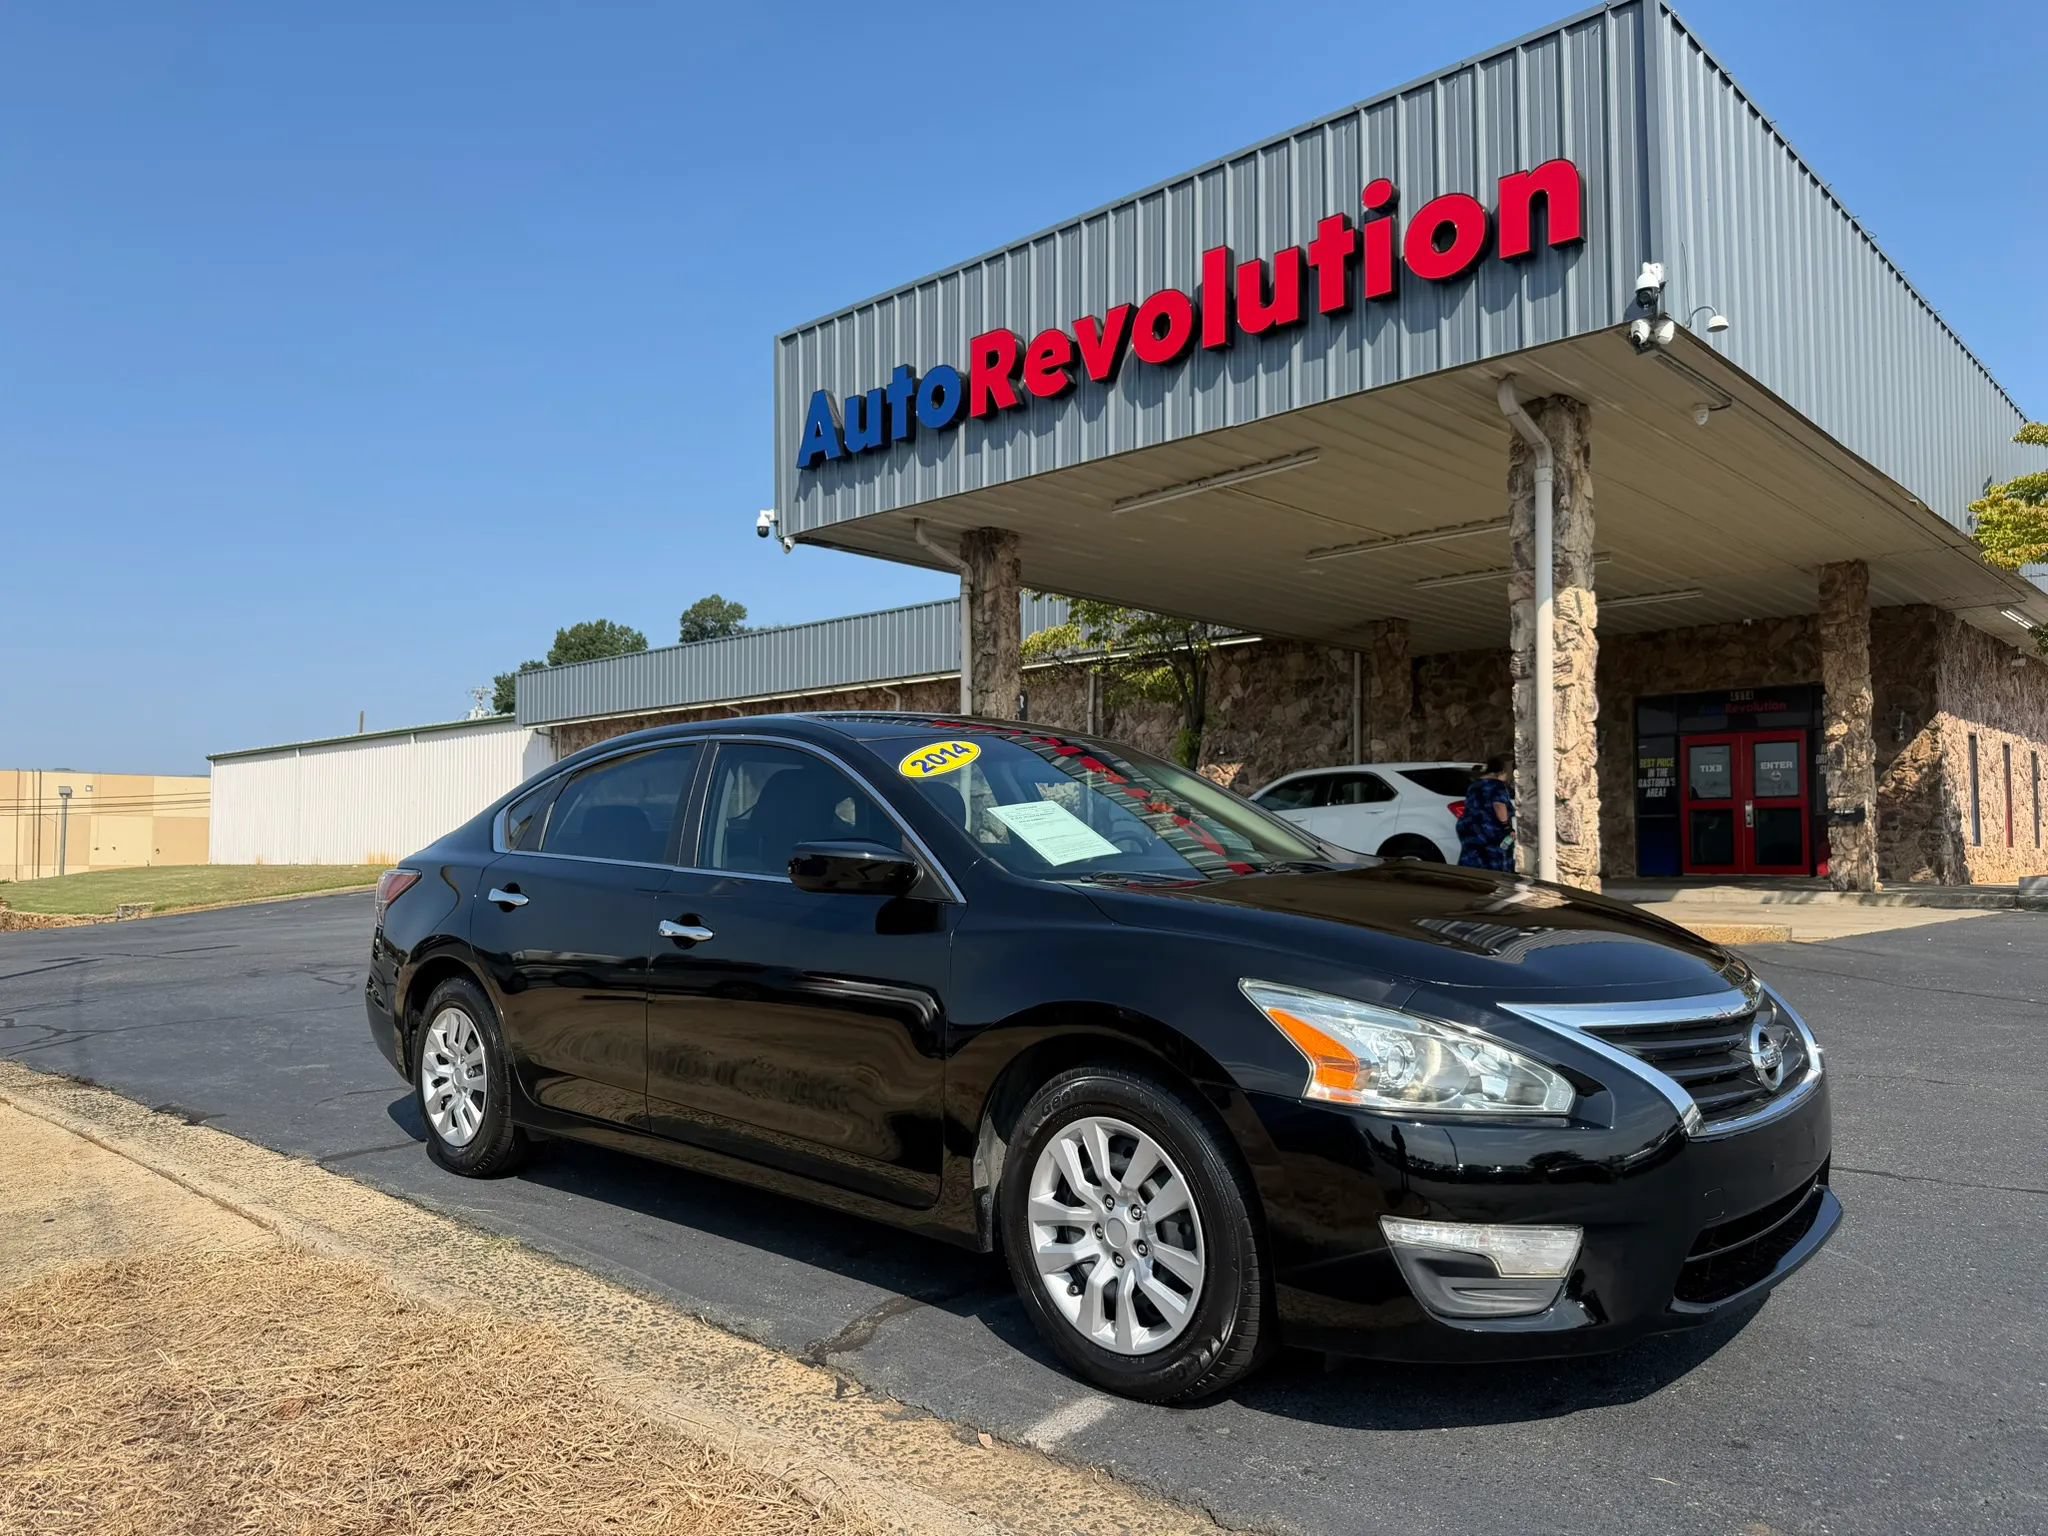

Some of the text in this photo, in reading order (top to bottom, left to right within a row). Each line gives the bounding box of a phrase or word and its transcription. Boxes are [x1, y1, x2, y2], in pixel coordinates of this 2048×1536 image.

[796, 158, 1584, 470] AutoRevolution
[911, 743, 972, 773] 2014
[1639, 757, 1675, 768] BEST PRICE
[1760, 761, 1793, 770] ENTER
[1647, 767, 1668, 777] IN THE
